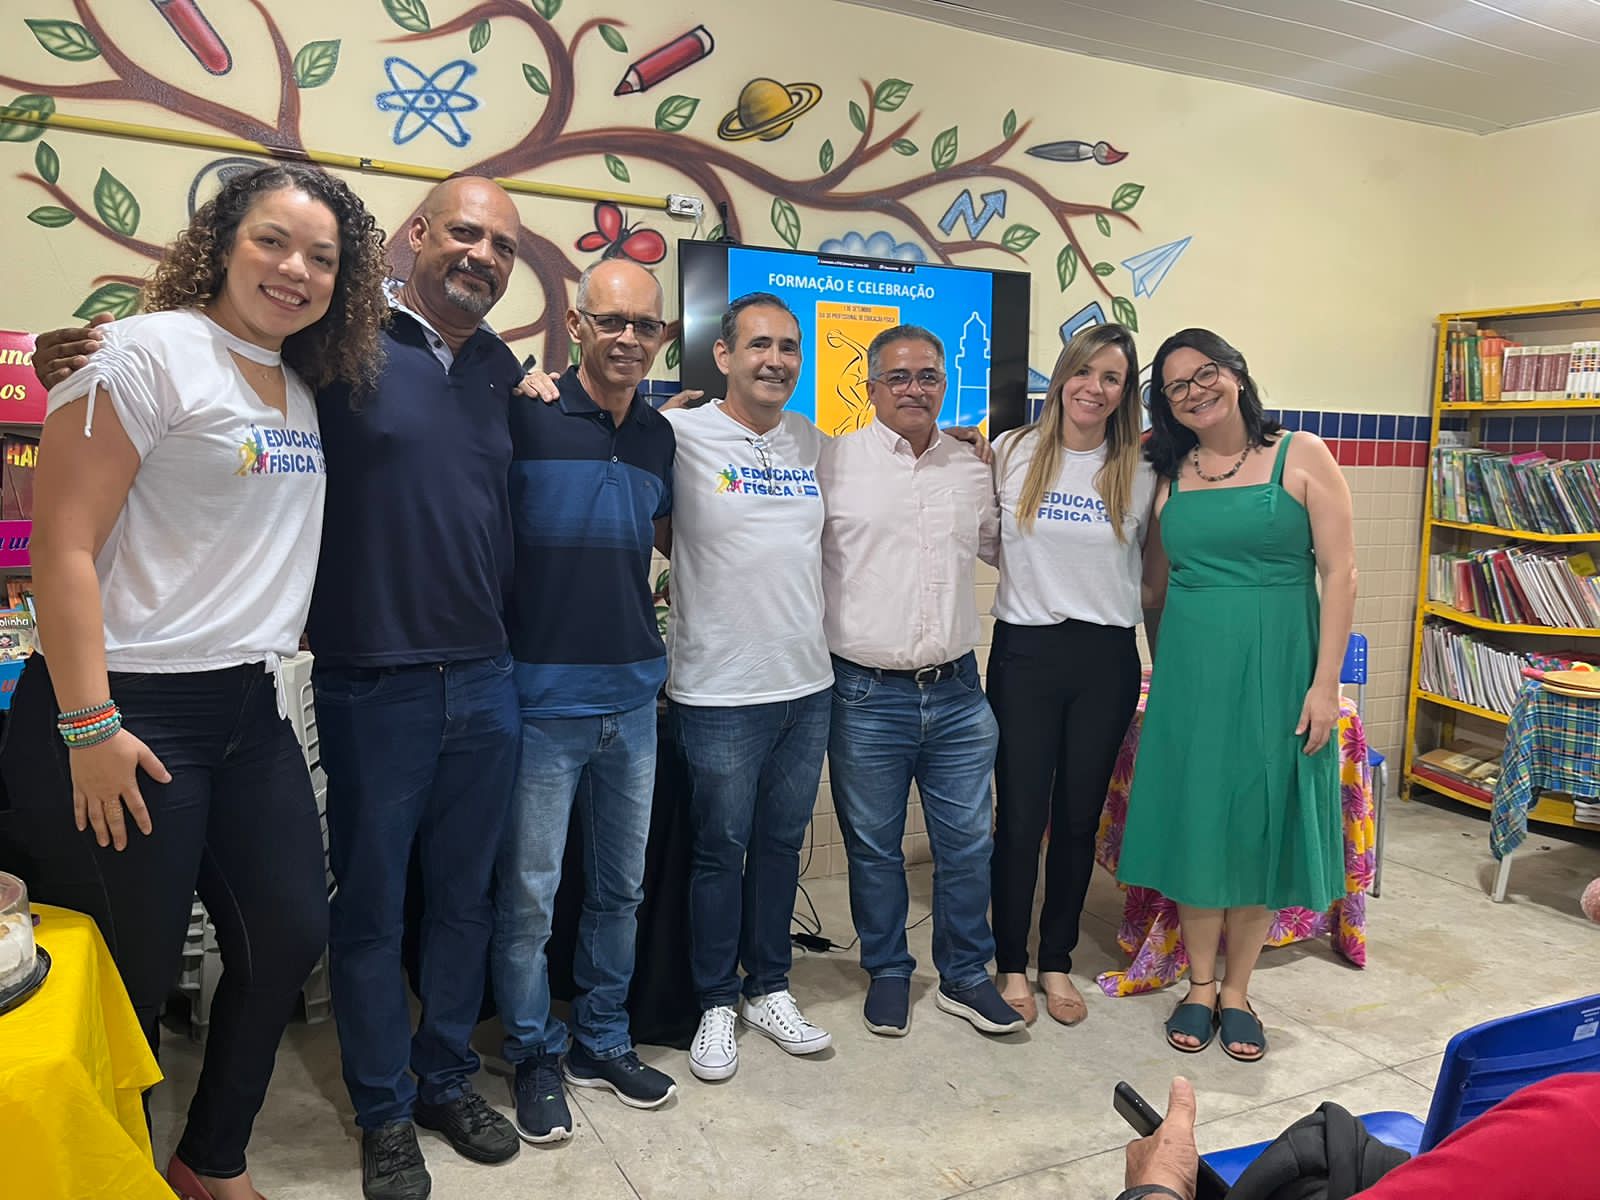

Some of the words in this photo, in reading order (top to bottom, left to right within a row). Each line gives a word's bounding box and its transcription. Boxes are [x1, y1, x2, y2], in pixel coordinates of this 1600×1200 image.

[768, 272, 844, 294] FORMAÇÃO
[847, 280, 855, 293] E
[857, 281, 935, 301] CELEBRAÇÃO
[269, 449, 317, 474] FÍSICA
[743, 480, 794, 496] FÍSICA
[1037, 504, 1092, 522] FÍSICA
[1040, 491, 1105, 513] EDUCAÇ
